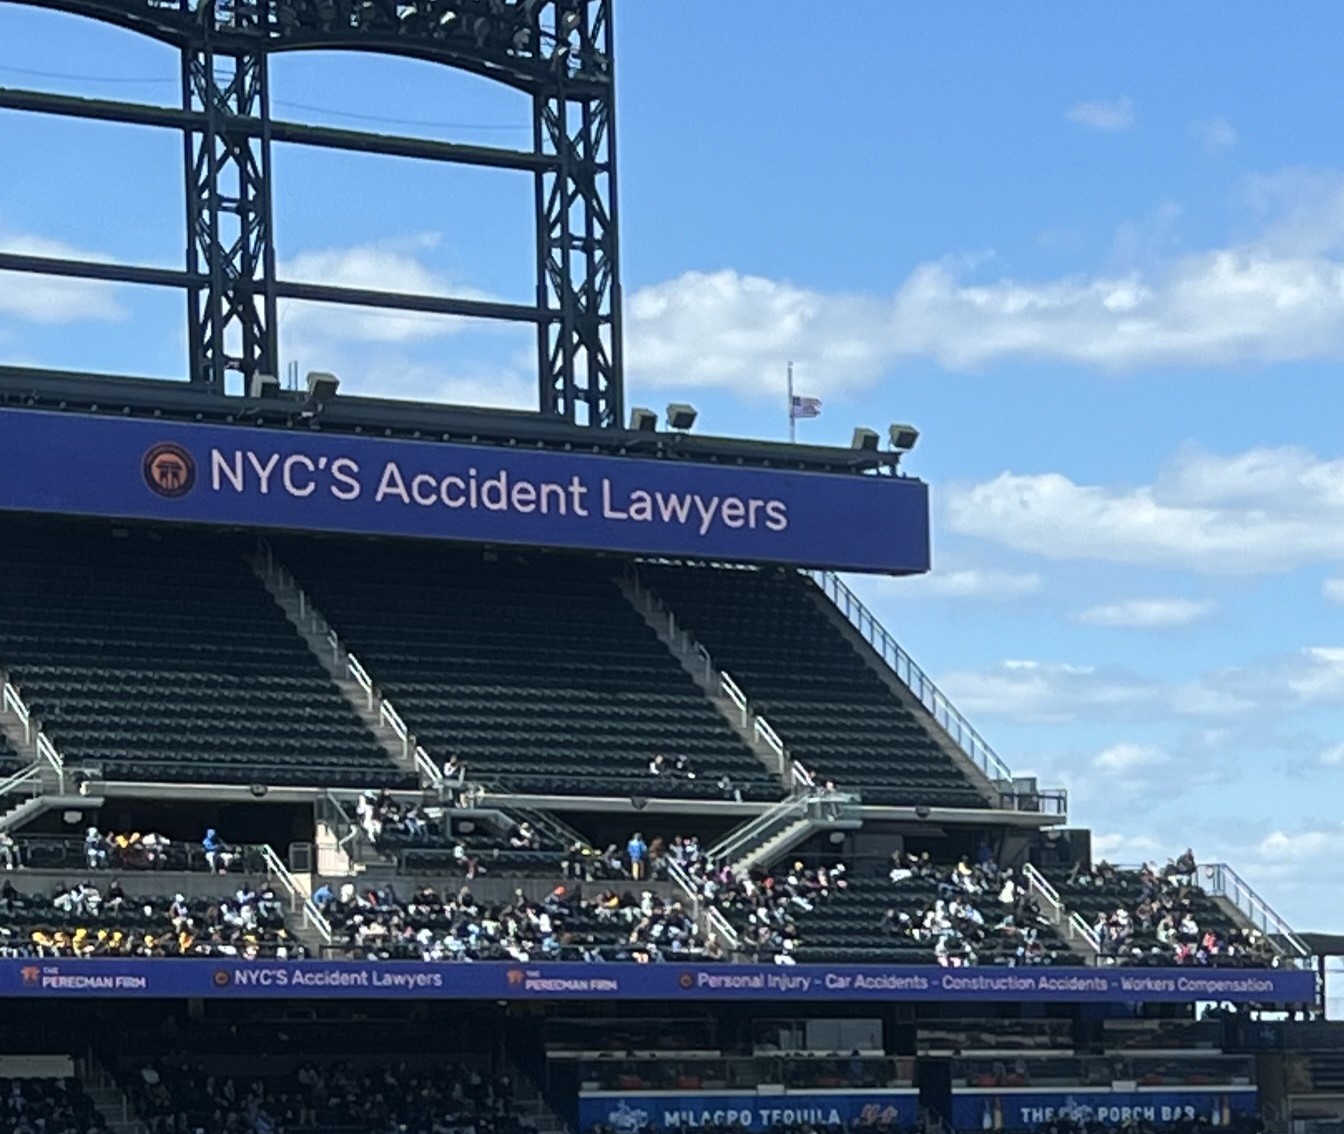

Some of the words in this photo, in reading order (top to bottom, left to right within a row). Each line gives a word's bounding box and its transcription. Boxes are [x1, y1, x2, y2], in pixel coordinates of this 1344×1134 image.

[211, 448, 361, 501] NYC'S
[375, 460, 590, 519] Accident
[602, 478, 790, 536] Lawyers
[116, 976, 146, 989] FIRM
[234, 969, 288, 986] NYC'S
[292, 970, 368, 987] Accident
[372, 970, 443, 990] Lawyers
[697, 973, 765, 988] Personal
[768, 973, 811, 992] Injury
[825, 973, 850, 989] Car
[854, 974, 929, 990] Accidents
[942, 975, 1036, 991] Construction
[1038, 976, 1109, 992] Accidents
[1120, 976, 1176, 992] Workers
[1178, 976, 1275, 995] Compensation
